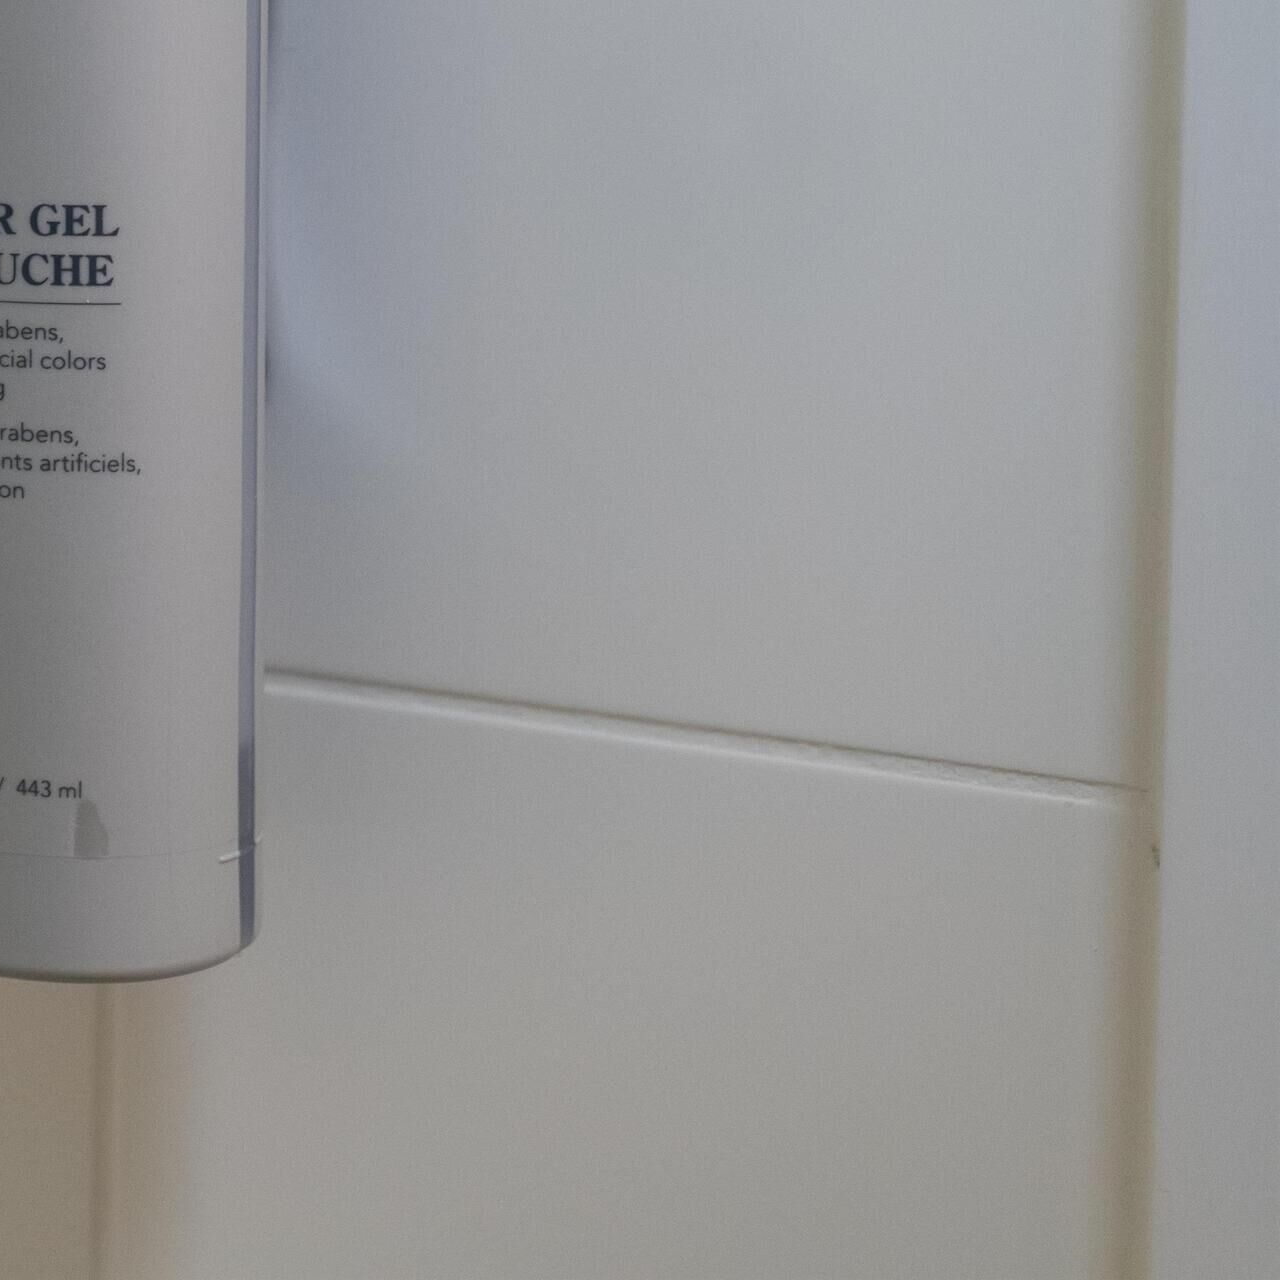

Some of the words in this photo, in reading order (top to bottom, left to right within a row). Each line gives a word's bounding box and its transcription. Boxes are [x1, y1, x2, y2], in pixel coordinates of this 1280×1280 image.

[29, 203, 120, 237] GEL
[40, 350, 107, 371] colors
[39, 452, 142, 475] artificiels,
[16, 778, 52, 798] 443
[58, 780, 83, 799] ml
